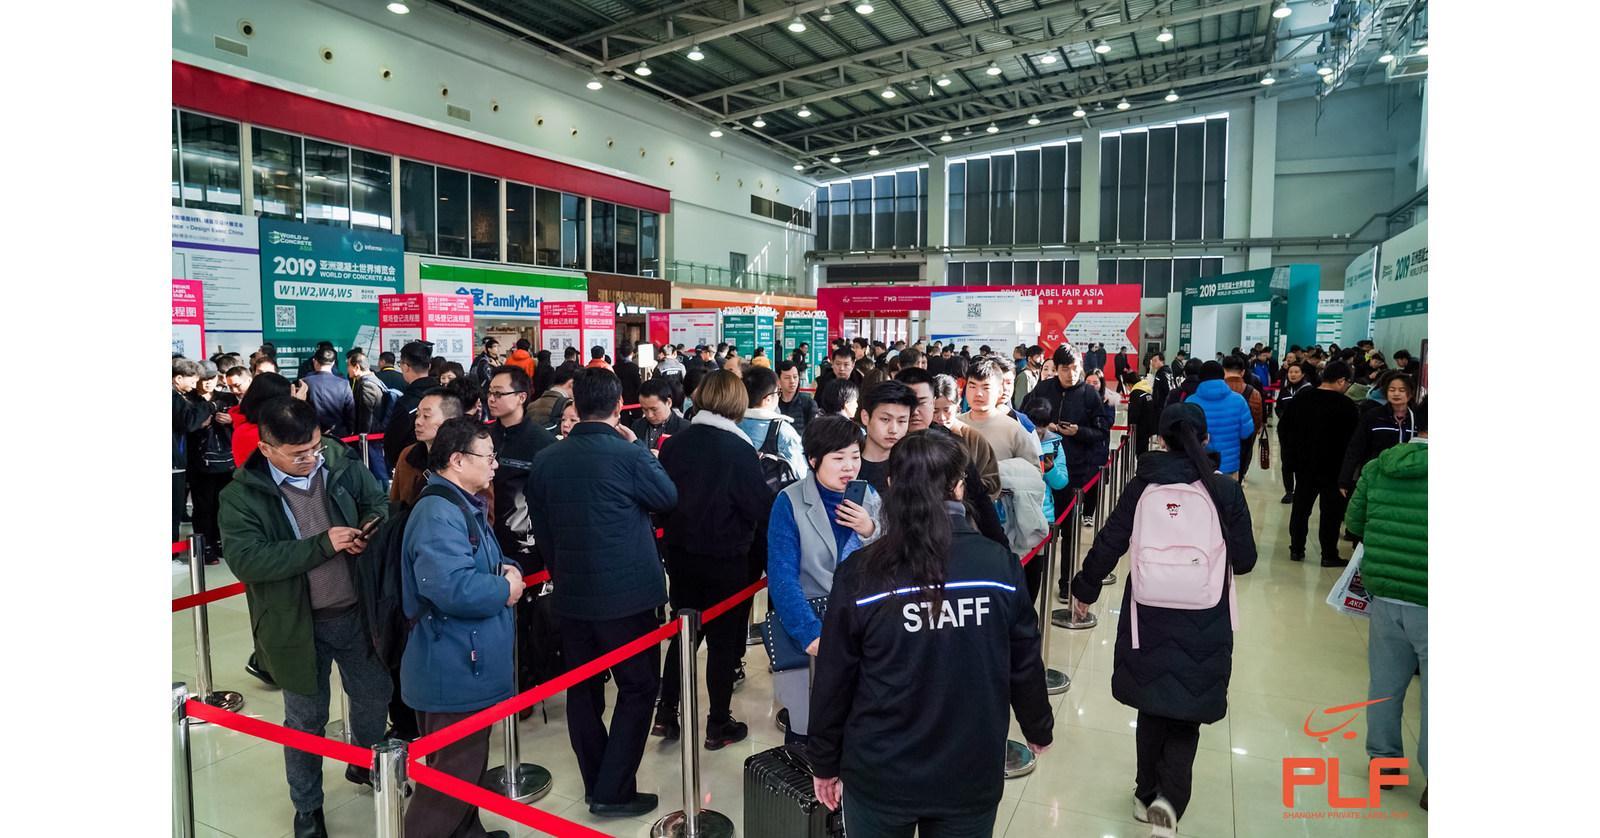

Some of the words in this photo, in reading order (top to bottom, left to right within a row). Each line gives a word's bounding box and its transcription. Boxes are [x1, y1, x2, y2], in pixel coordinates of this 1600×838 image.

[280, 232, 302, 240] WORLD
[280, 238, 312, 246] CONCRETE
[273, 256, 317, 276] 2019
[319, 260, 396, 276] 亚洲混凝土世界博览会
[1394, 254, 1410, 281] 2019
[319, 271, 343, 279] WORLD
[352, 273, 382, 281] CONCRETE
[279, 285, 353, 298] W1,W2,W4,W5
[1034, 289, 1060, 297] LABEL
[1061, 289, 1080, 297] FAIR
[1082, 289, 1104, 297] ASIA
[1199, 283, 1217, 298] 2019
[486, 293, 544, 311] FamilyMart
[902, 597, 990, 633] STAFF
